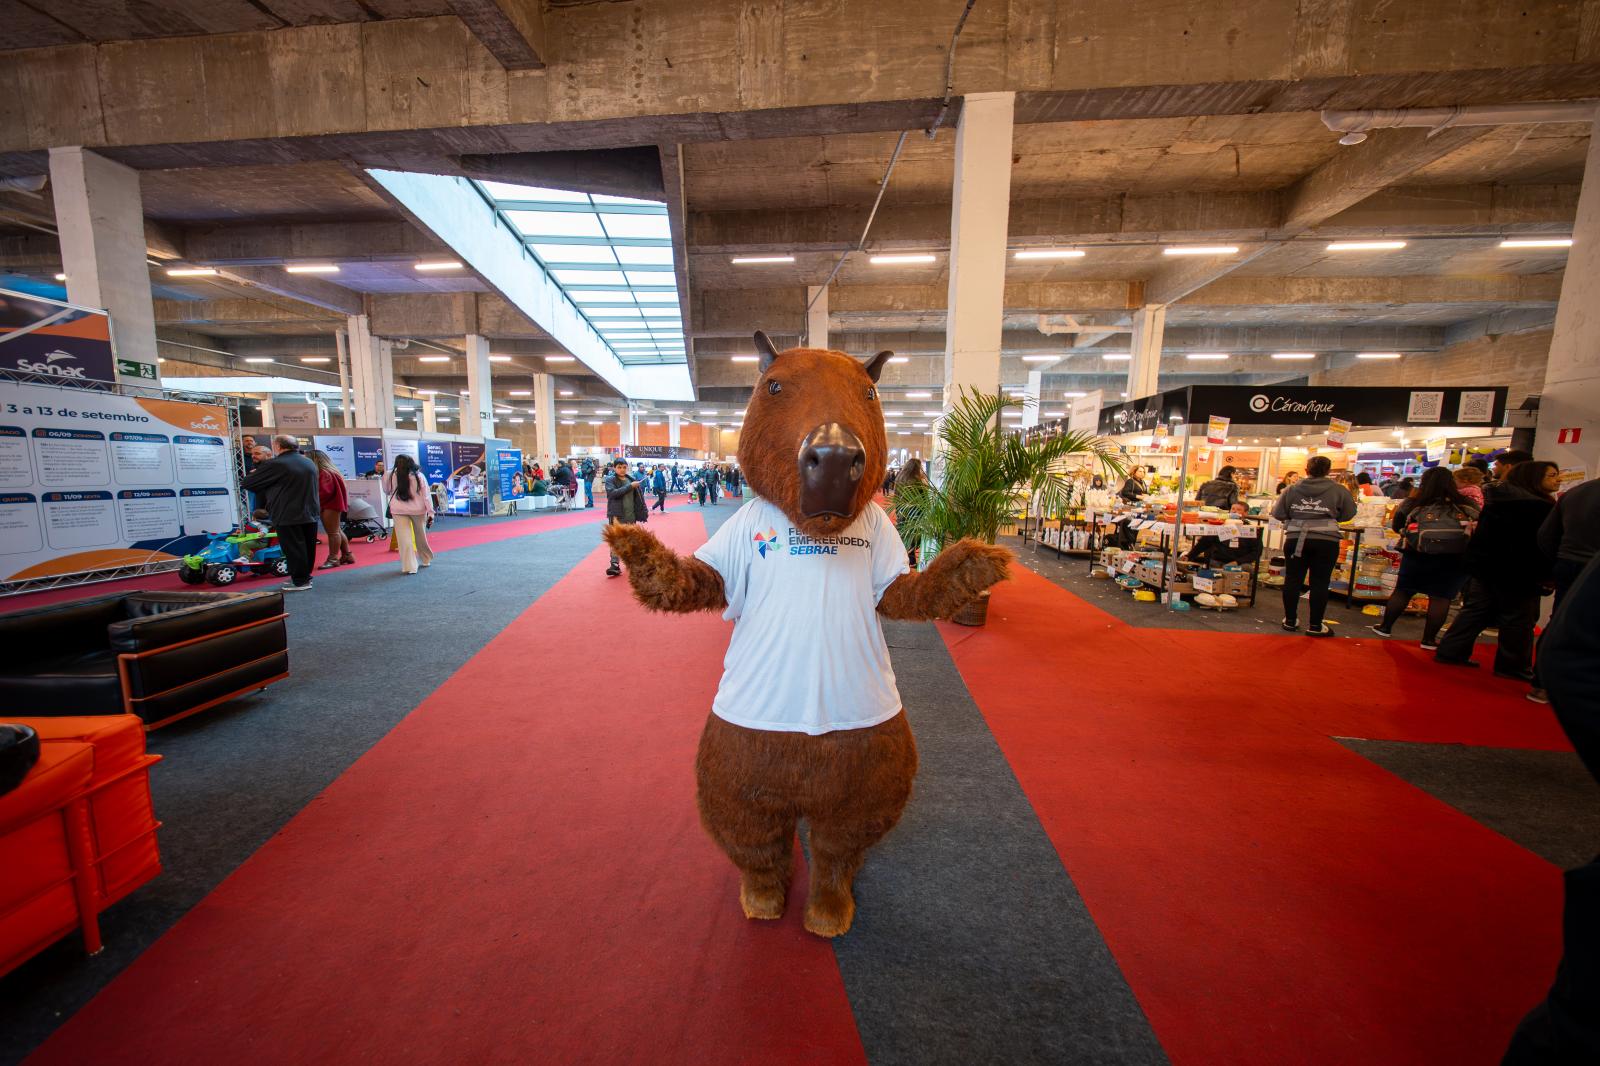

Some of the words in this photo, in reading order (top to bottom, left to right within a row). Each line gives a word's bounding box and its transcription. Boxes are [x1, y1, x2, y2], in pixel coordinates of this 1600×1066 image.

[17, 359, 87, 380] Senac
[7, 403, 17, 413] 3
[22, 407, 33, 416] a
[36, 405, 53, 416] 13
[57, 407, 77, 418] de
[82, 409, 149, 423] setembro
[1271, 396, 1335, 421] Céramique
[790, 545, 838, 555] SEBRAE
